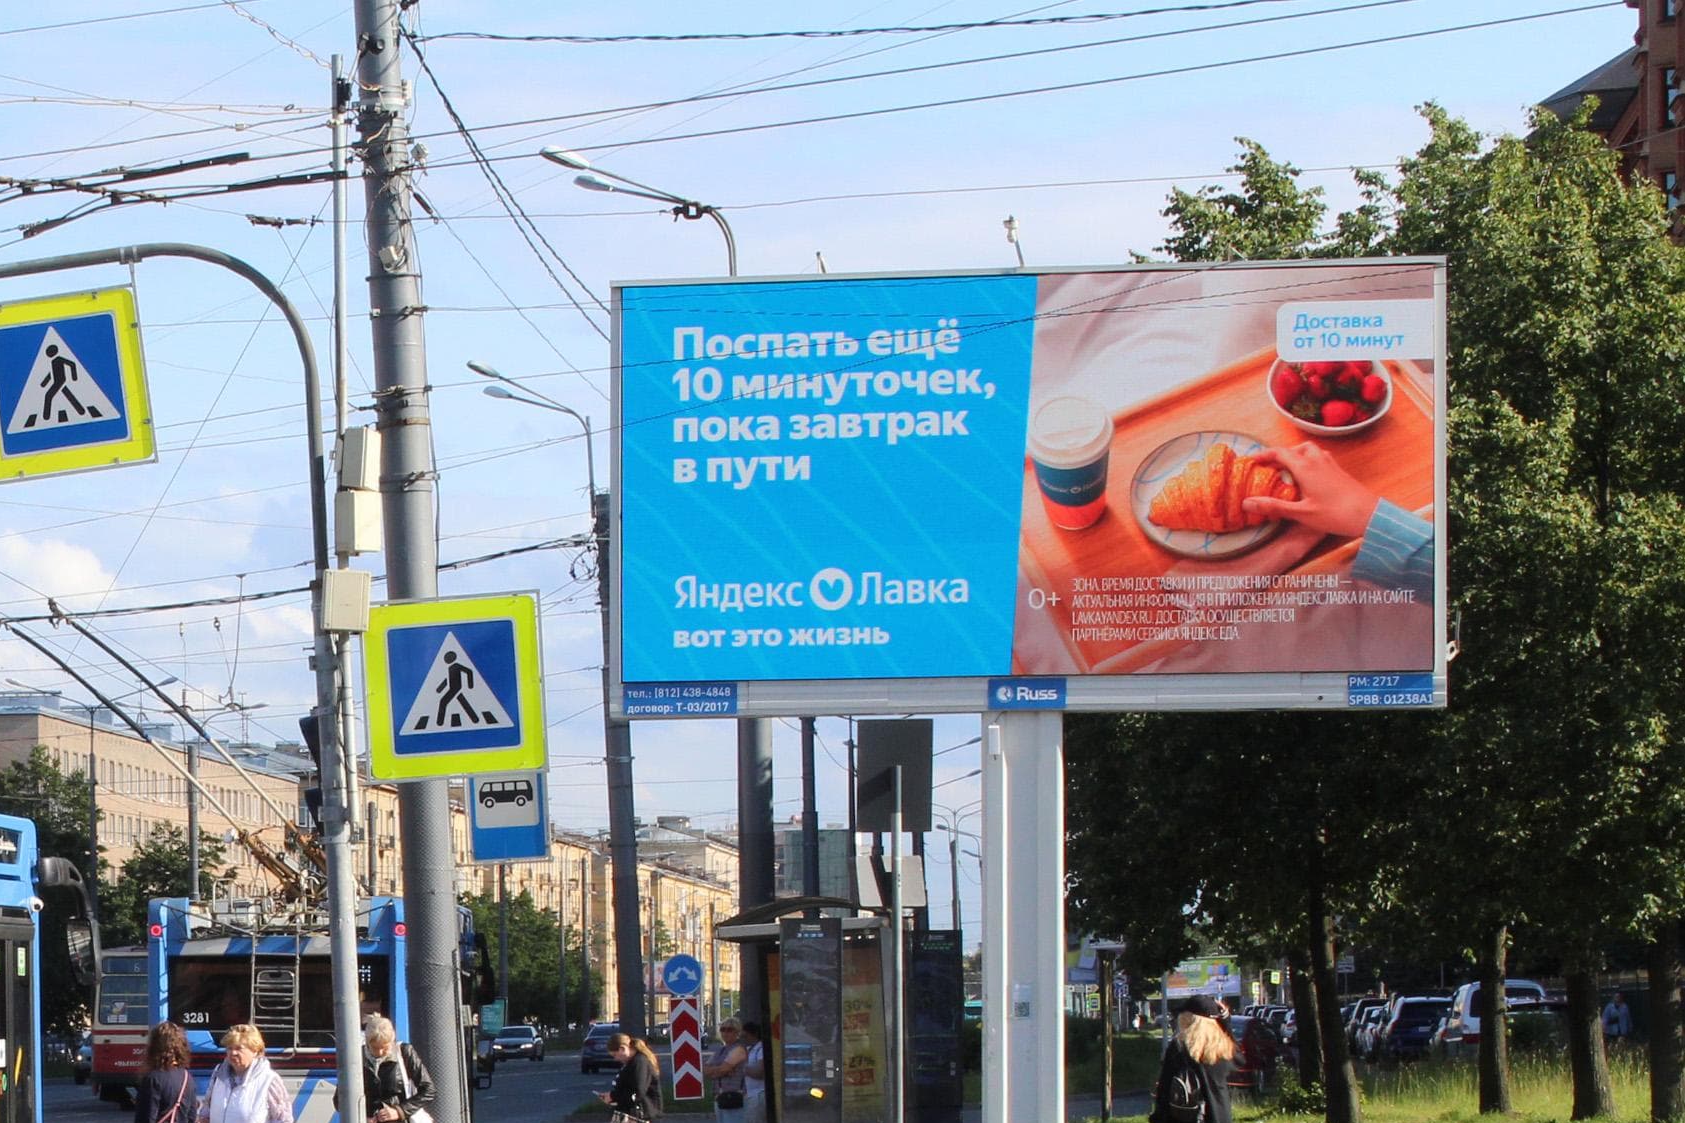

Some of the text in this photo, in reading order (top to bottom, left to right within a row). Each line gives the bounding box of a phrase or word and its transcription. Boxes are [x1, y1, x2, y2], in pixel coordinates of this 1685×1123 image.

[1293, 313, 1384, 332] Доставка
[673, 318, 961, 361] Поспать ещё
[1294, 332, 1405, 350] от 10 минут
[672, 366, 997, 406] 10 минуточек,
[673, 410, 969, 445] пока завтрак
[673, 455, 811, 490] в пути
[674, 572, 969, 613] Яндекс Лавка
[1101, 577, 1134, 592] ВРЕМЯ
[1135, 576, 1186, 592] ДОСТАВКИ
[1272, 574, 1339, 589] ОГРАНИЧЕНЫ
[1028, 588, 1061, 610] 0+
[1072, 594, 1133, 608] АКТУАЛЬНАЯ
[1368, 590, 1383, 604] НА
[1383, 587, 1416, 604] САЙТЕ
[673, 626, 891, 649] вот это жизнь
[1372, 676, 1400, 687] 2717
[627, 690, 652, 699] тел.:
[682, 687, 731, 698] 438-4848
[1016, 686, 1058, 701] Russ
[627, 702, 729, 715] договор: Т-03/2017
[183, 1012, 210, 1024] 3281
